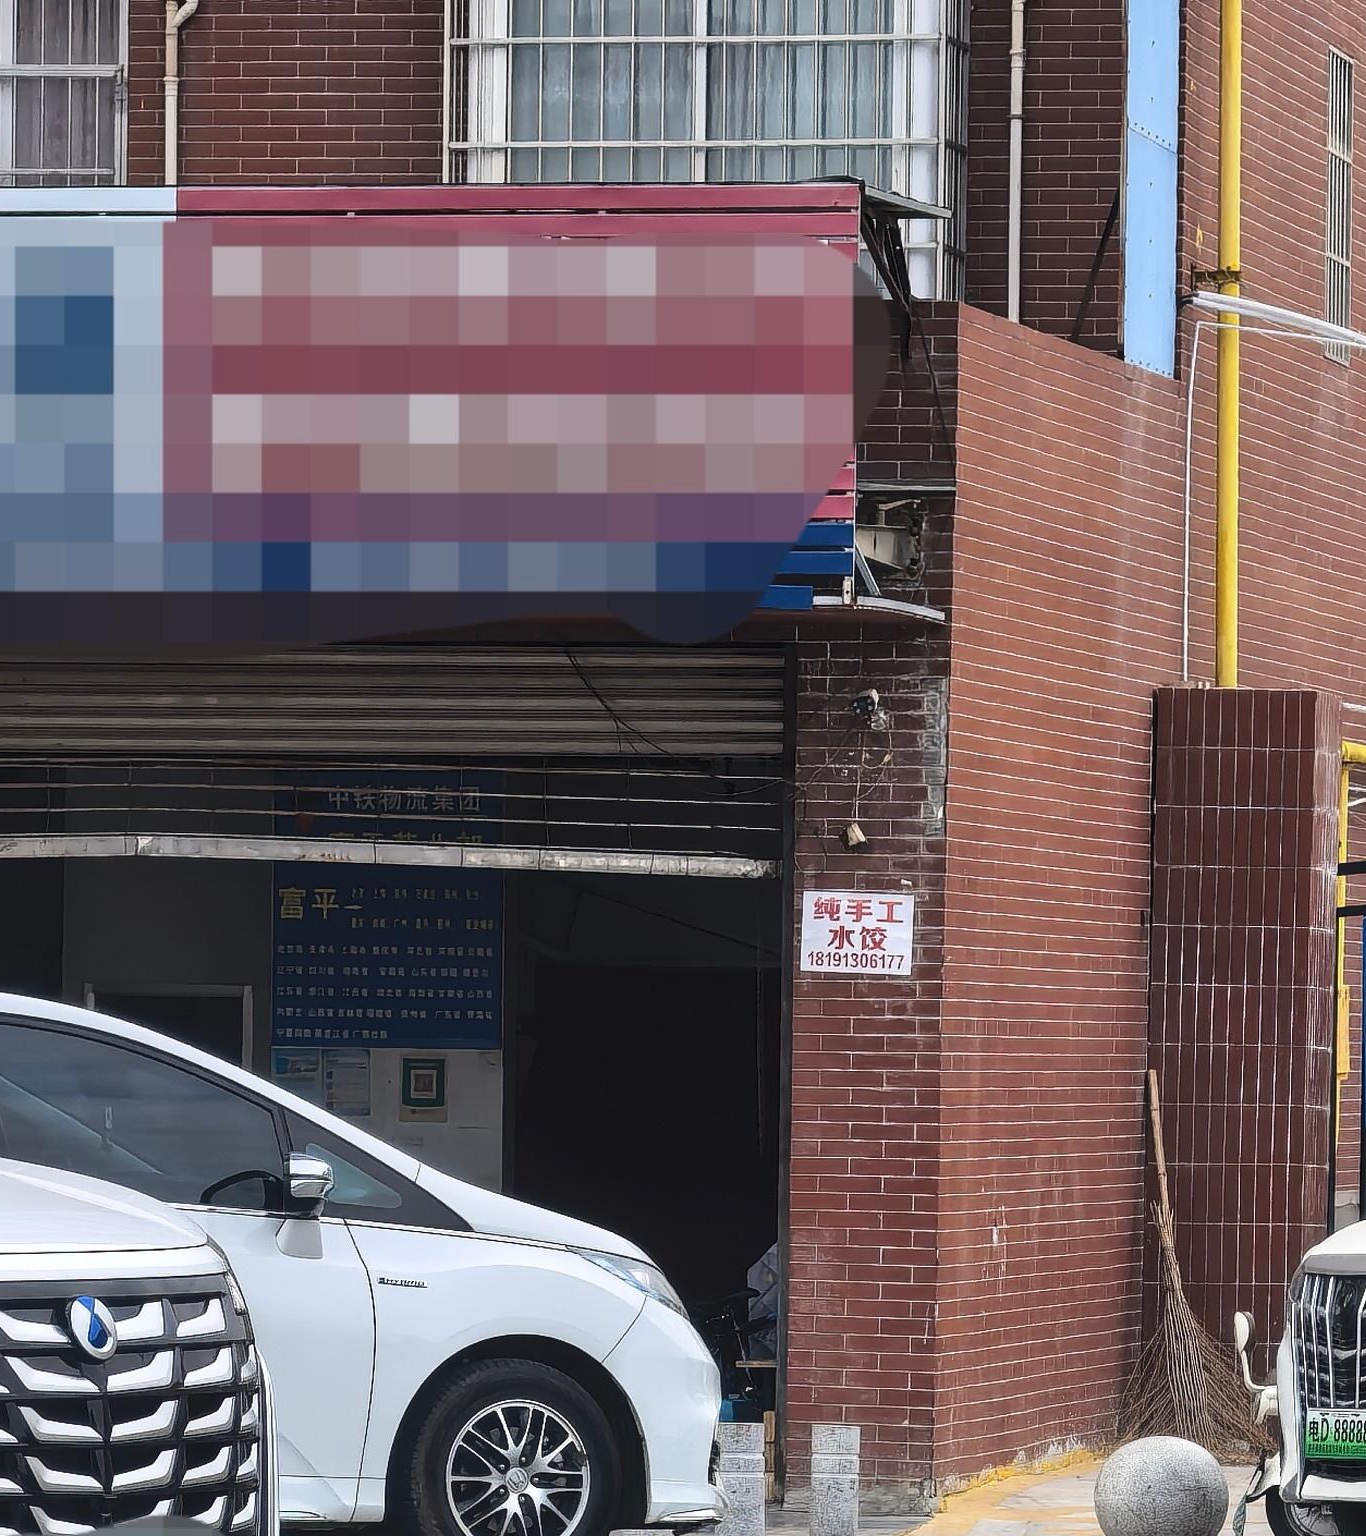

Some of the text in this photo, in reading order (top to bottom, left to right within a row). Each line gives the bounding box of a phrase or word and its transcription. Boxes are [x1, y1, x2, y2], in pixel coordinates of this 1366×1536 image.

[278, 887, 339, 920] 富平
[813, 897, 904, 923] 纯手工
[827, 925, 887, 951] 水饺
[807, 951, 905, 970] 18191306177
